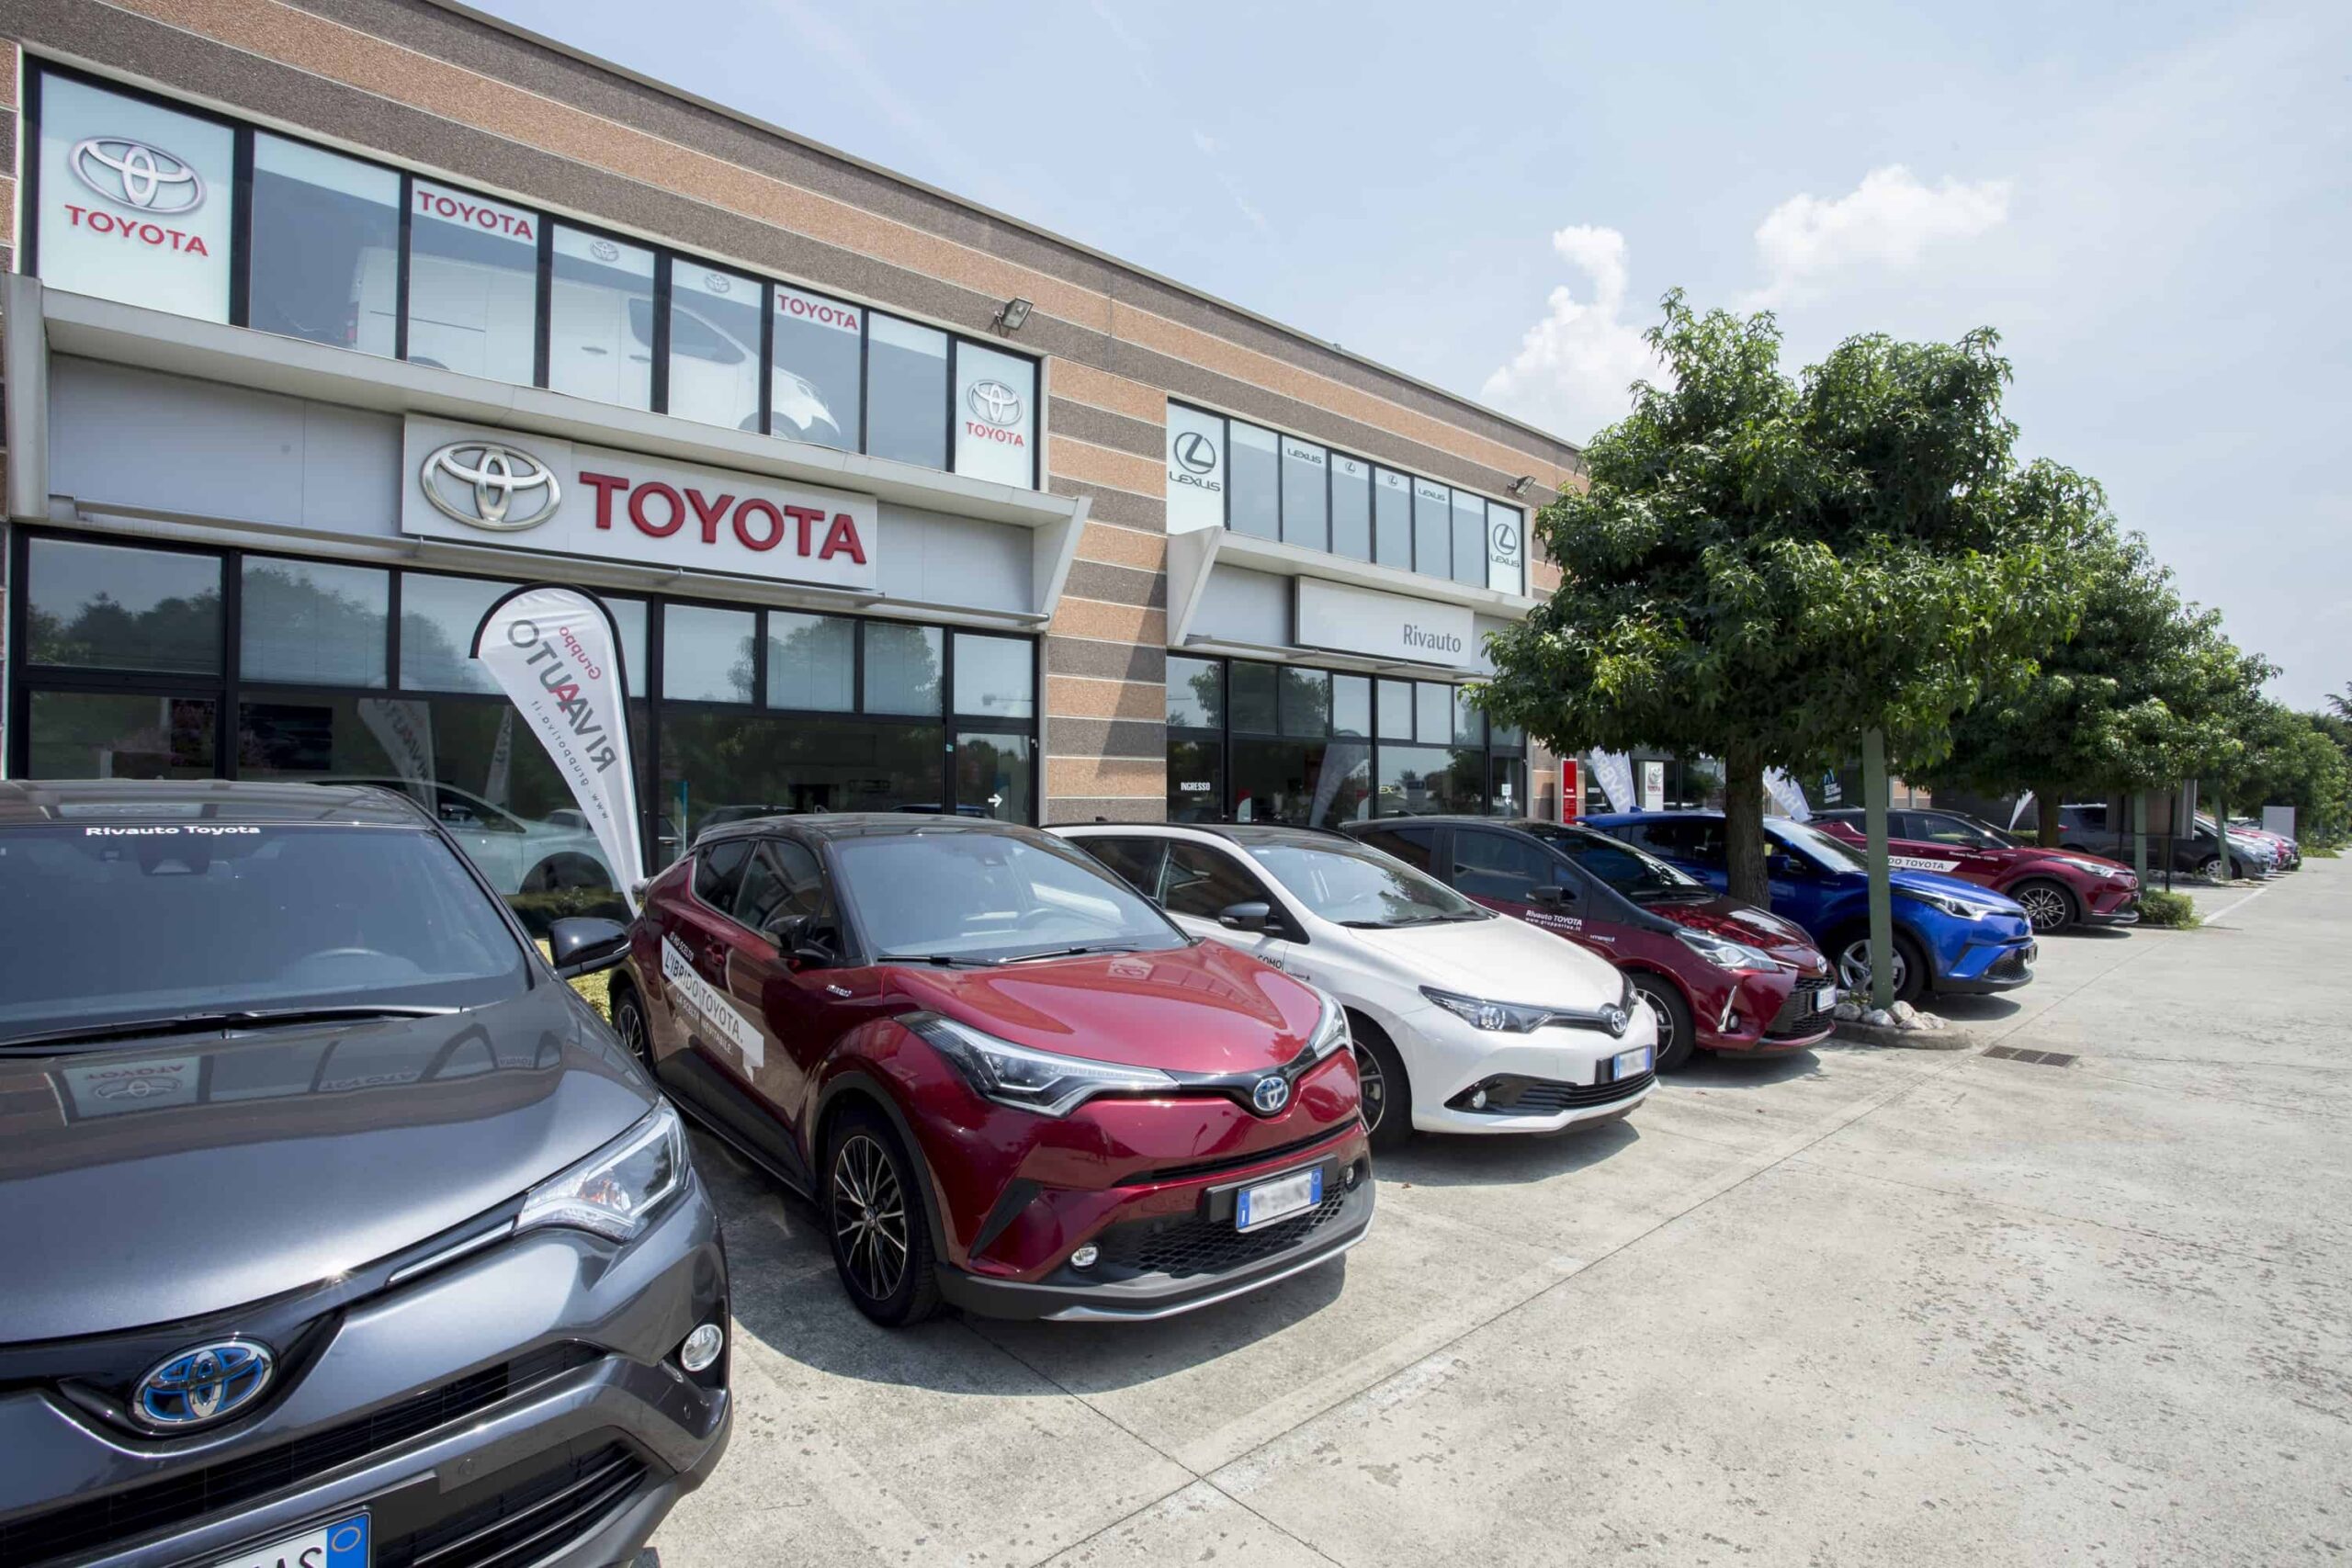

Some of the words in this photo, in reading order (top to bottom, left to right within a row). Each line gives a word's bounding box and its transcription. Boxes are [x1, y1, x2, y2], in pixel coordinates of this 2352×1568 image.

[418, 189, 533, 241] TOYOTA
[64, 204, 209, 257] TOYOTA
[777, 294, 858, 331] TOYOTA
[965, 421, 1024, 448] TOYOTA
[1287, 447, 1322, 465] LEXUS
[1169, 470, 1221, 492] LEXUS
[1418, 487, 1446, 502] LEXUS
[579, 470, 867, 565] TOYOTA
[1489, 553, 1521, 569] LEXUS
[1403, 623, 1462, 654] Rivauto
[1181, 782, 1210, 791] INGRESSO
[85, 826, 179, 836] Rivauto
[184, 826, 261, 836] Toyota
[1526, 909, 1553, 920] Rivauto
[1554, 915, 1582, 926] TOYOTA
